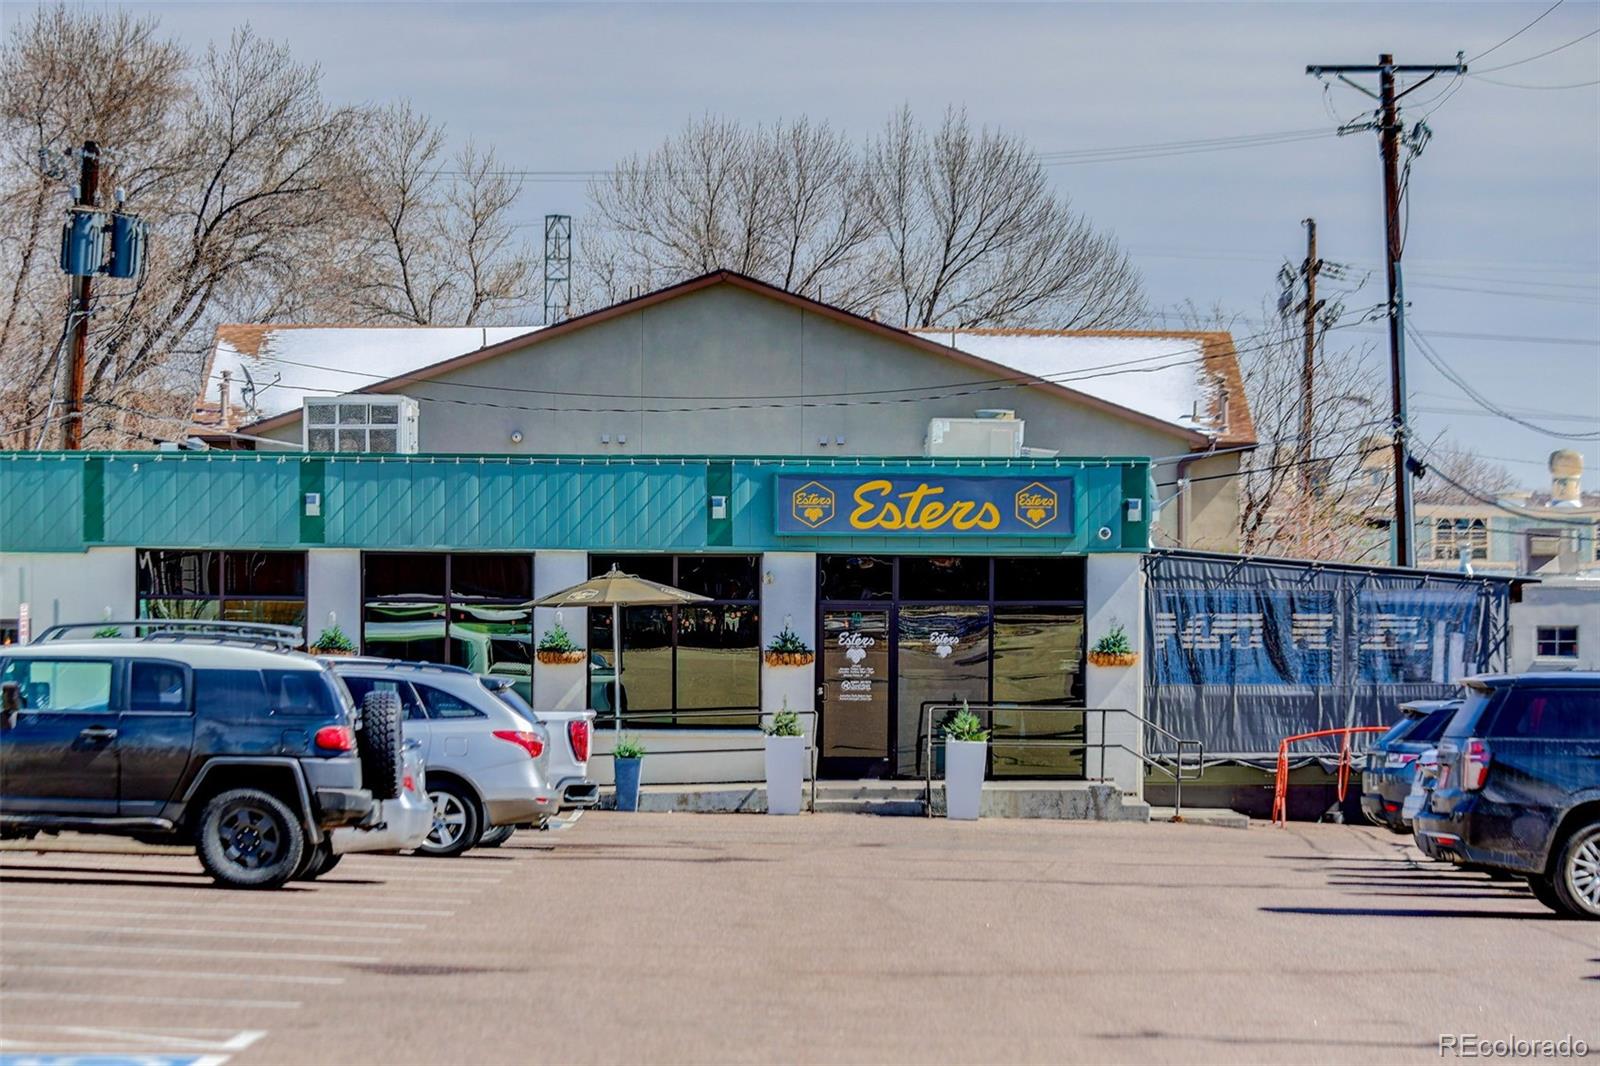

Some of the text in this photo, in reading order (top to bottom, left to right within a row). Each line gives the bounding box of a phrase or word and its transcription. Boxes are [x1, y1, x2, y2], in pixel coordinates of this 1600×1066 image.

[796, 492, 831, 505] Esters
[850, 480, 1000, 530] Esters
[1019, 493, 1054, 506] Esters
[838, 631, 875, 646] Esters
[929, 632, 959, 645] Esters
